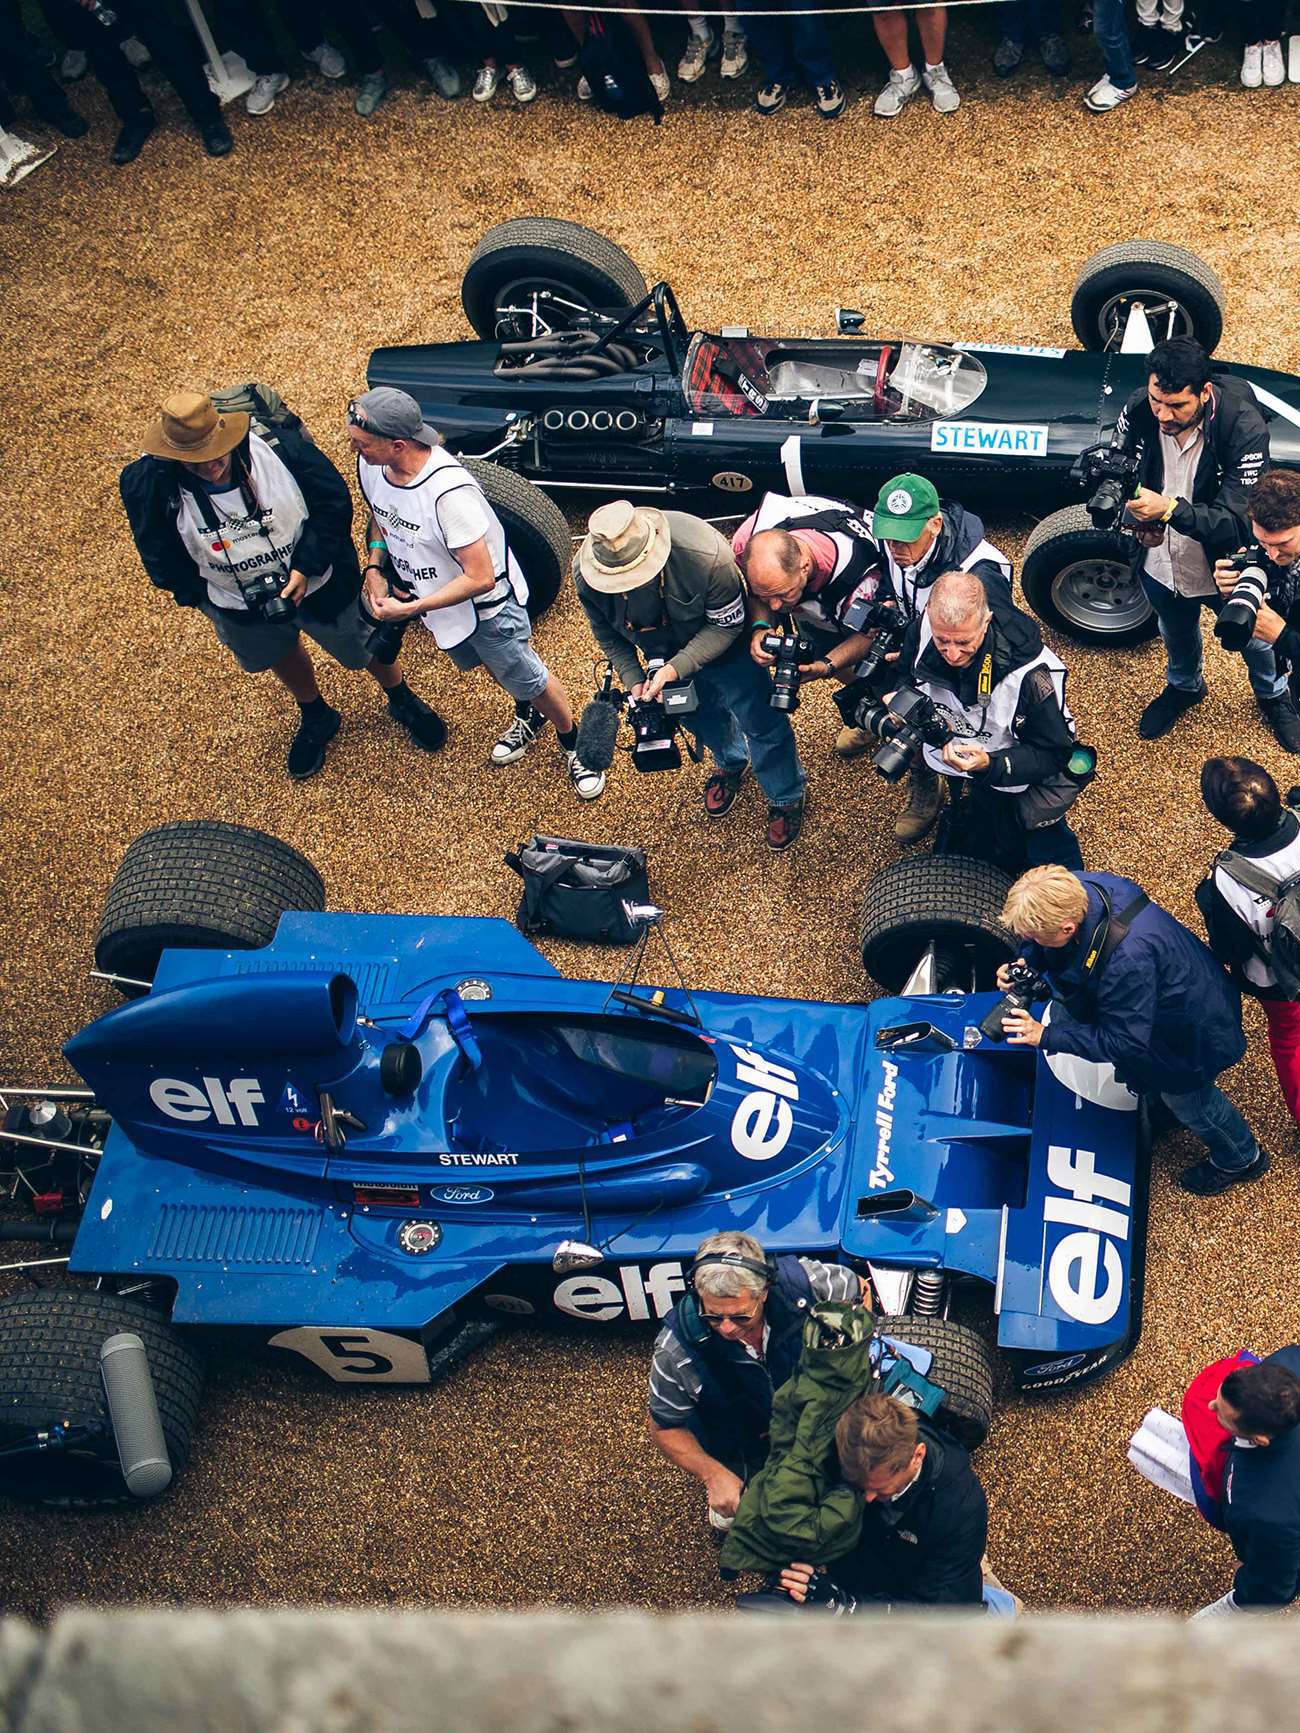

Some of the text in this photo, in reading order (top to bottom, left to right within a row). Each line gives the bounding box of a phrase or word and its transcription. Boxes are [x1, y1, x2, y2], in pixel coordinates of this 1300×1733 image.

[935, 426, 1043, 451] STEWART
[719, 477, 746, 489] 417
[207, 540, 296, 574] PHOTOGRAPHE
[149, 1076, 266, 1127] elf
[728, 1043, 800, 1161] elf
[868, 1060, 899, 1189] Tyrrell Ford
[438, 1153, 519, 1166] STEWART
[443, 1186, 481, 1201] Ford
[1043, 1145, 1132, 1325] elf
[554, 1262, 687, 1321] elf
[319, 1335, 394, 1375] 5
[1021, 1354, 1108, 1390] GOODYEAR
